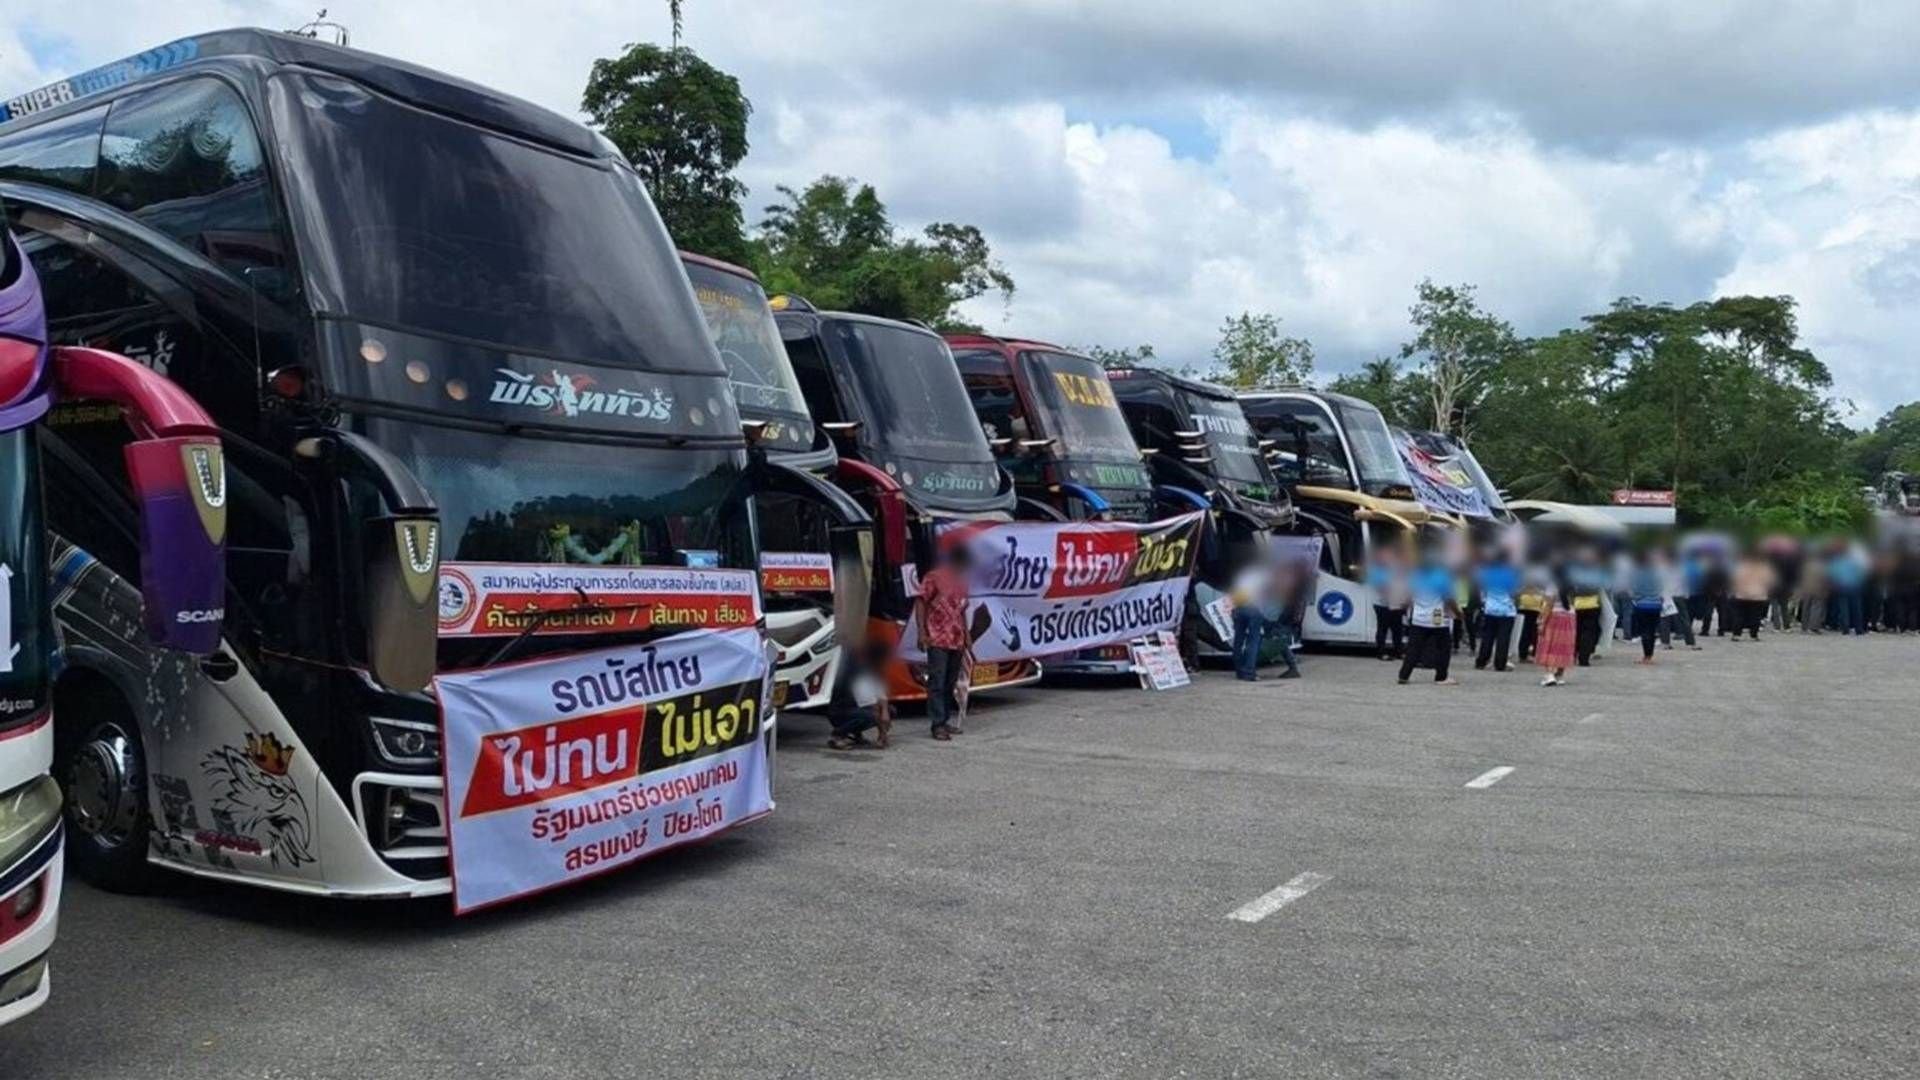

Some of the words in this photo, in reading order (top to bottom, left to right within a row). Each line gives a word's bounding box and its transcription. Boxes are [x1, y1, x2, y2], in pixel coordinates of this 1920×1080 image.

[8, 78, 75, 120] SUPER
[1061, 540, 1130, 587] ไม่ทน
[176, 607, 225, 623] SCAN
[551, 646, 702, 713] รถบัสไทย
[495, 726, 628, 797] ไม่ทน
[656, 695, 755, 758] ไม่เอา
[531, 760, 738, 842] รัฐมนตรีช่วยคมนาคม
